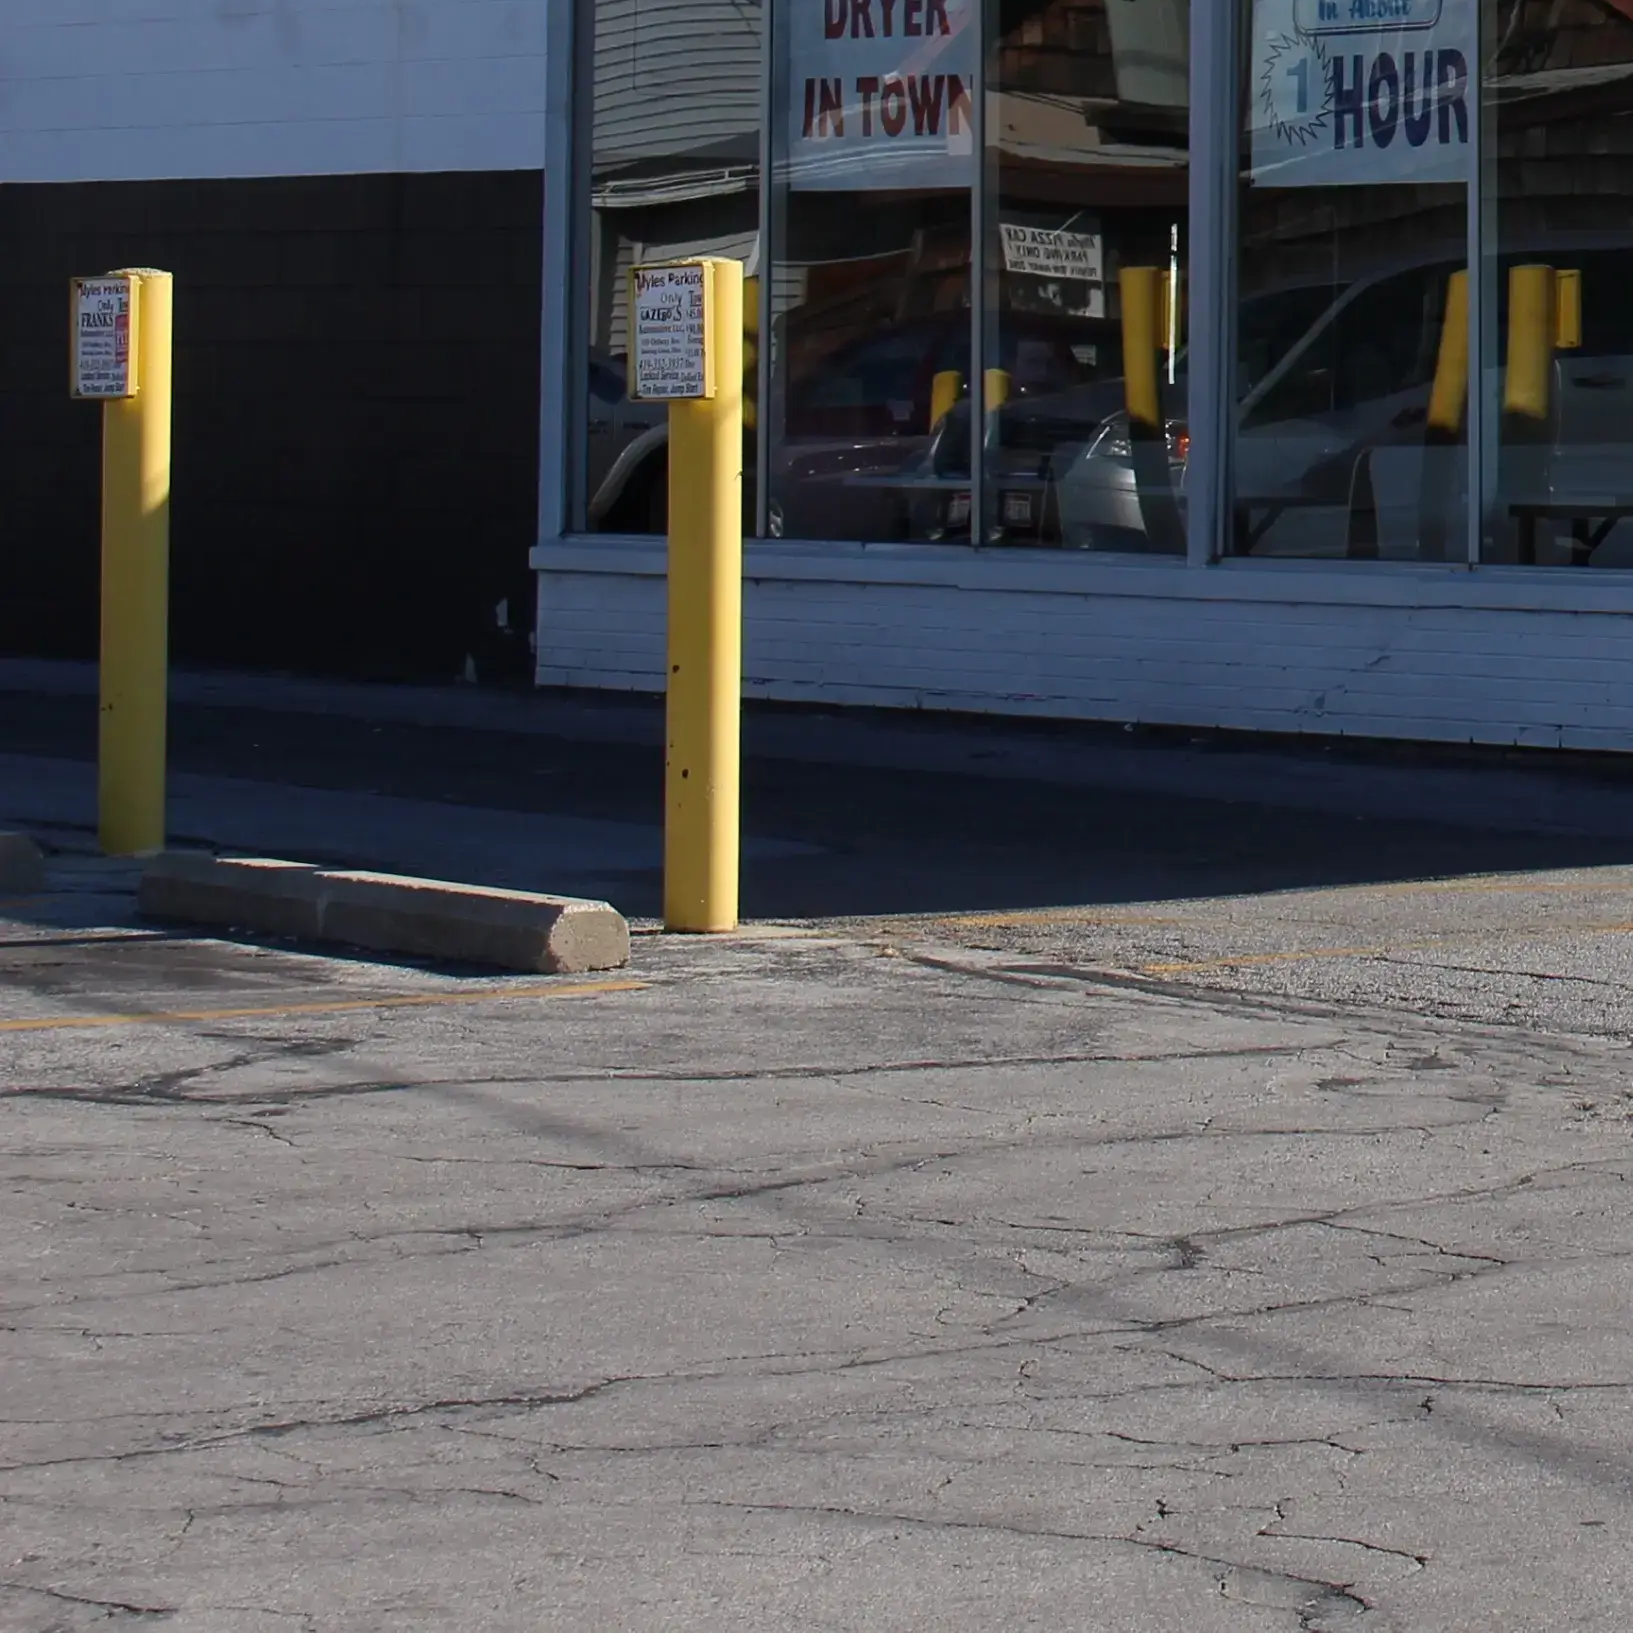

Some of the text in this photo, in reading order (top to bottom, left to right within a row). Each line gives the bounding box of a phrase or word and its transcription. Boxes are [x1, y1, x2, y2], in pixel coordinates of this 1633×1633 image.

[802, 74, 973, 138] IN TOWN
[1286, 48, 1469, 149] 1 HOUR
[81, 312, 114, 327] FRANKS
